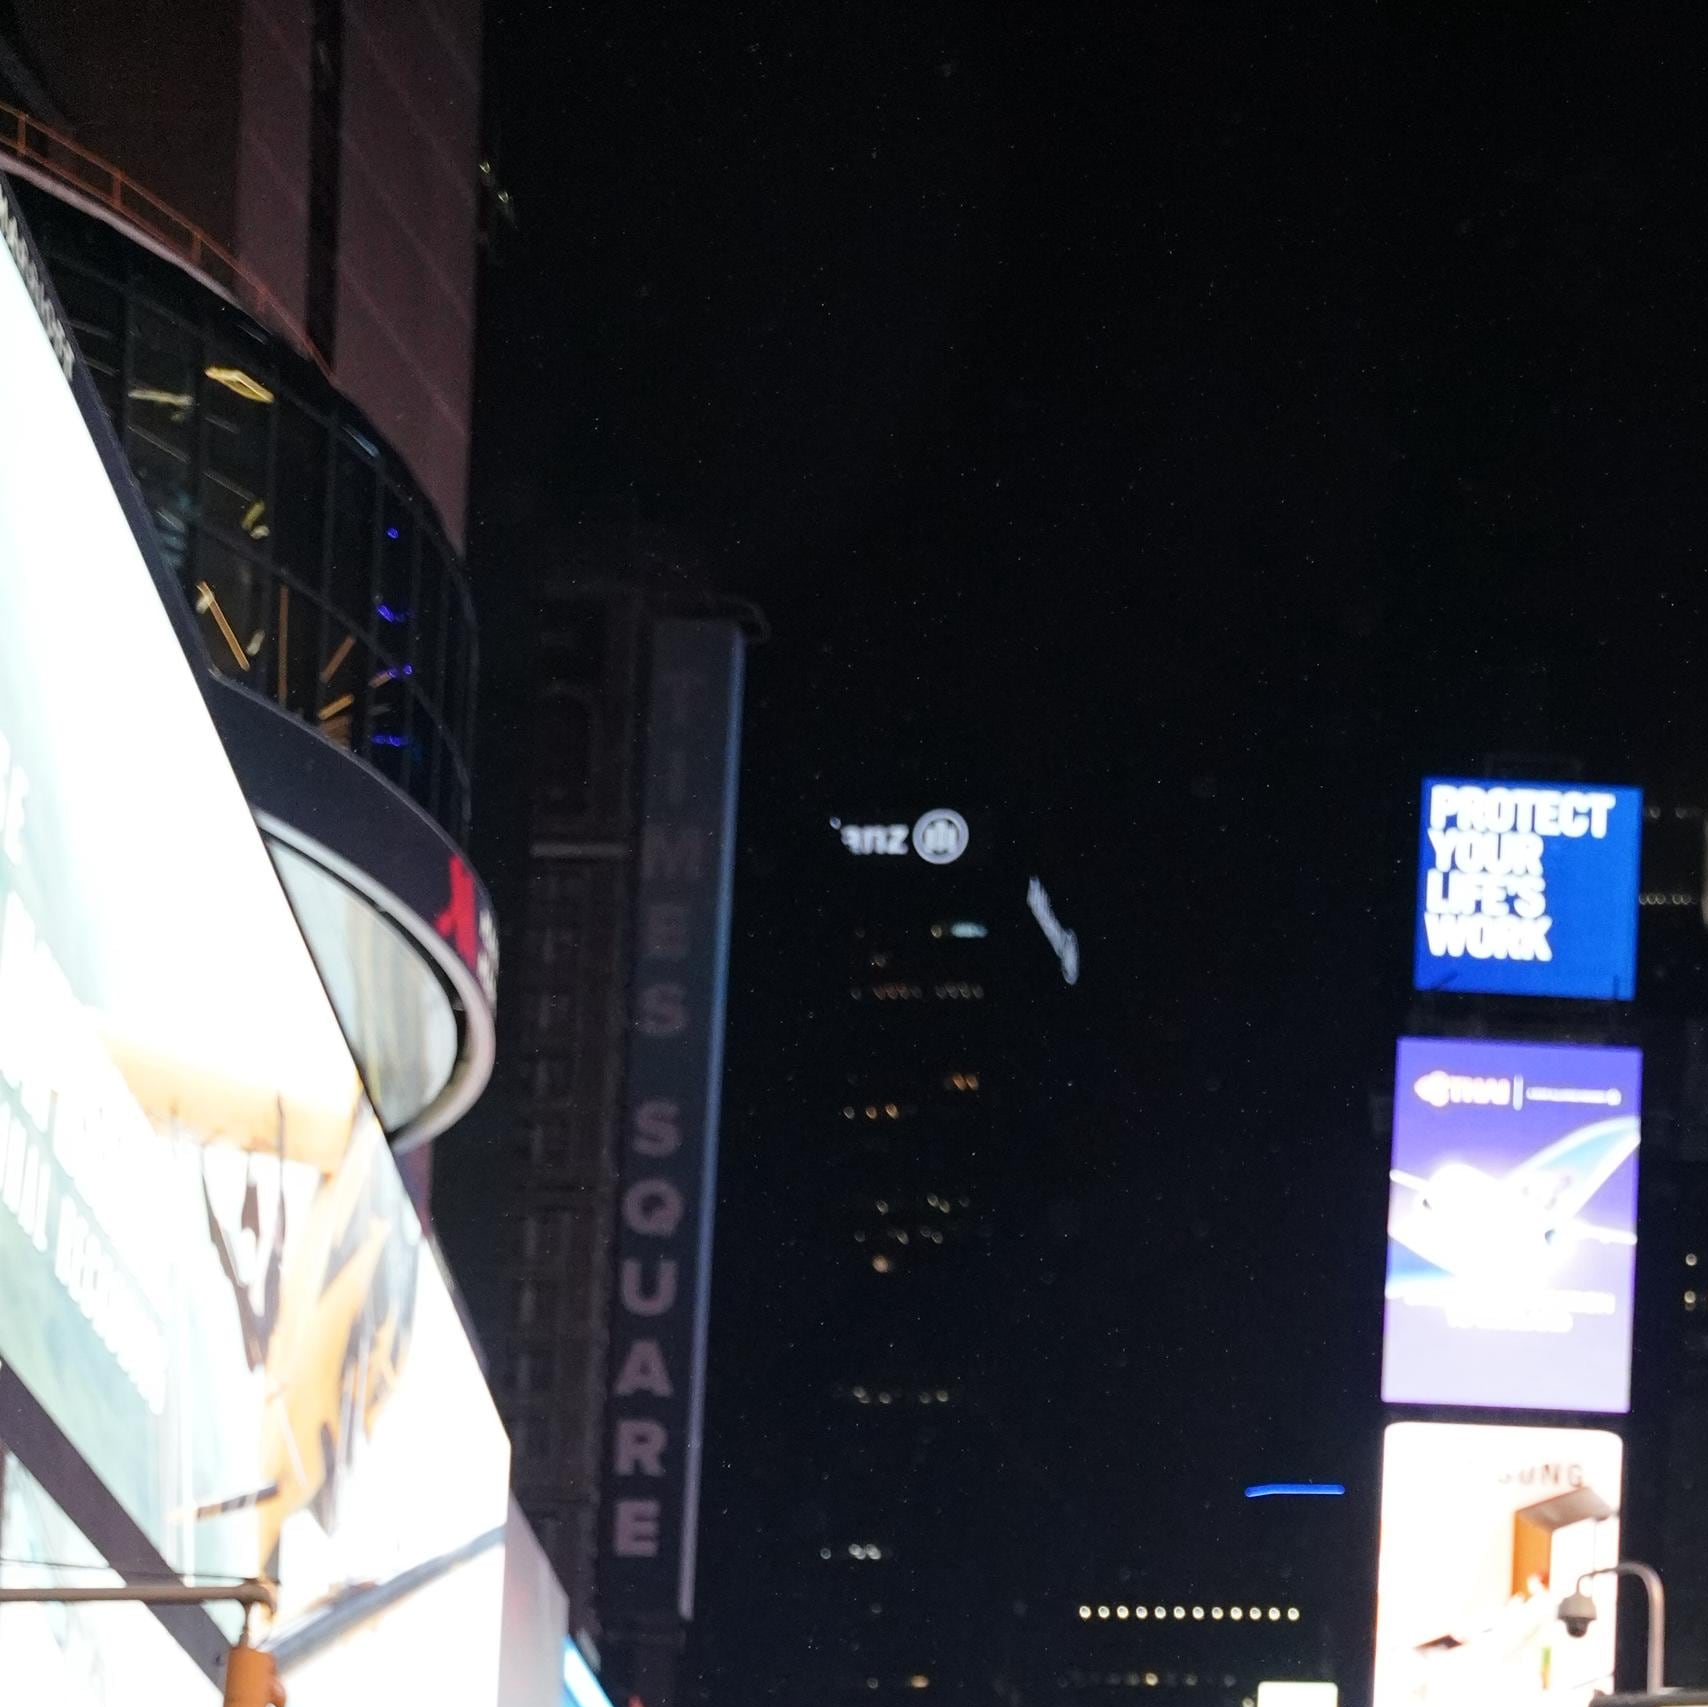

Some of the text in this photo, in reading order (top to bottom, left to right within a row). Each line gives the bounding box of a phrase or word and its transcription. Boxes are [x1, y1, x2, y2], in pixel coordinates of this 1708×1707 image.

[1430, 784, 1616, 839] PROTECT
[1428, 828, 1544, 876] YOUR
[1427, 868, 1546, 918] LIFE'S
[1424, 912, 1552, 961] WORK
[612, 670, 706, 1559] TIMES SQUARE
